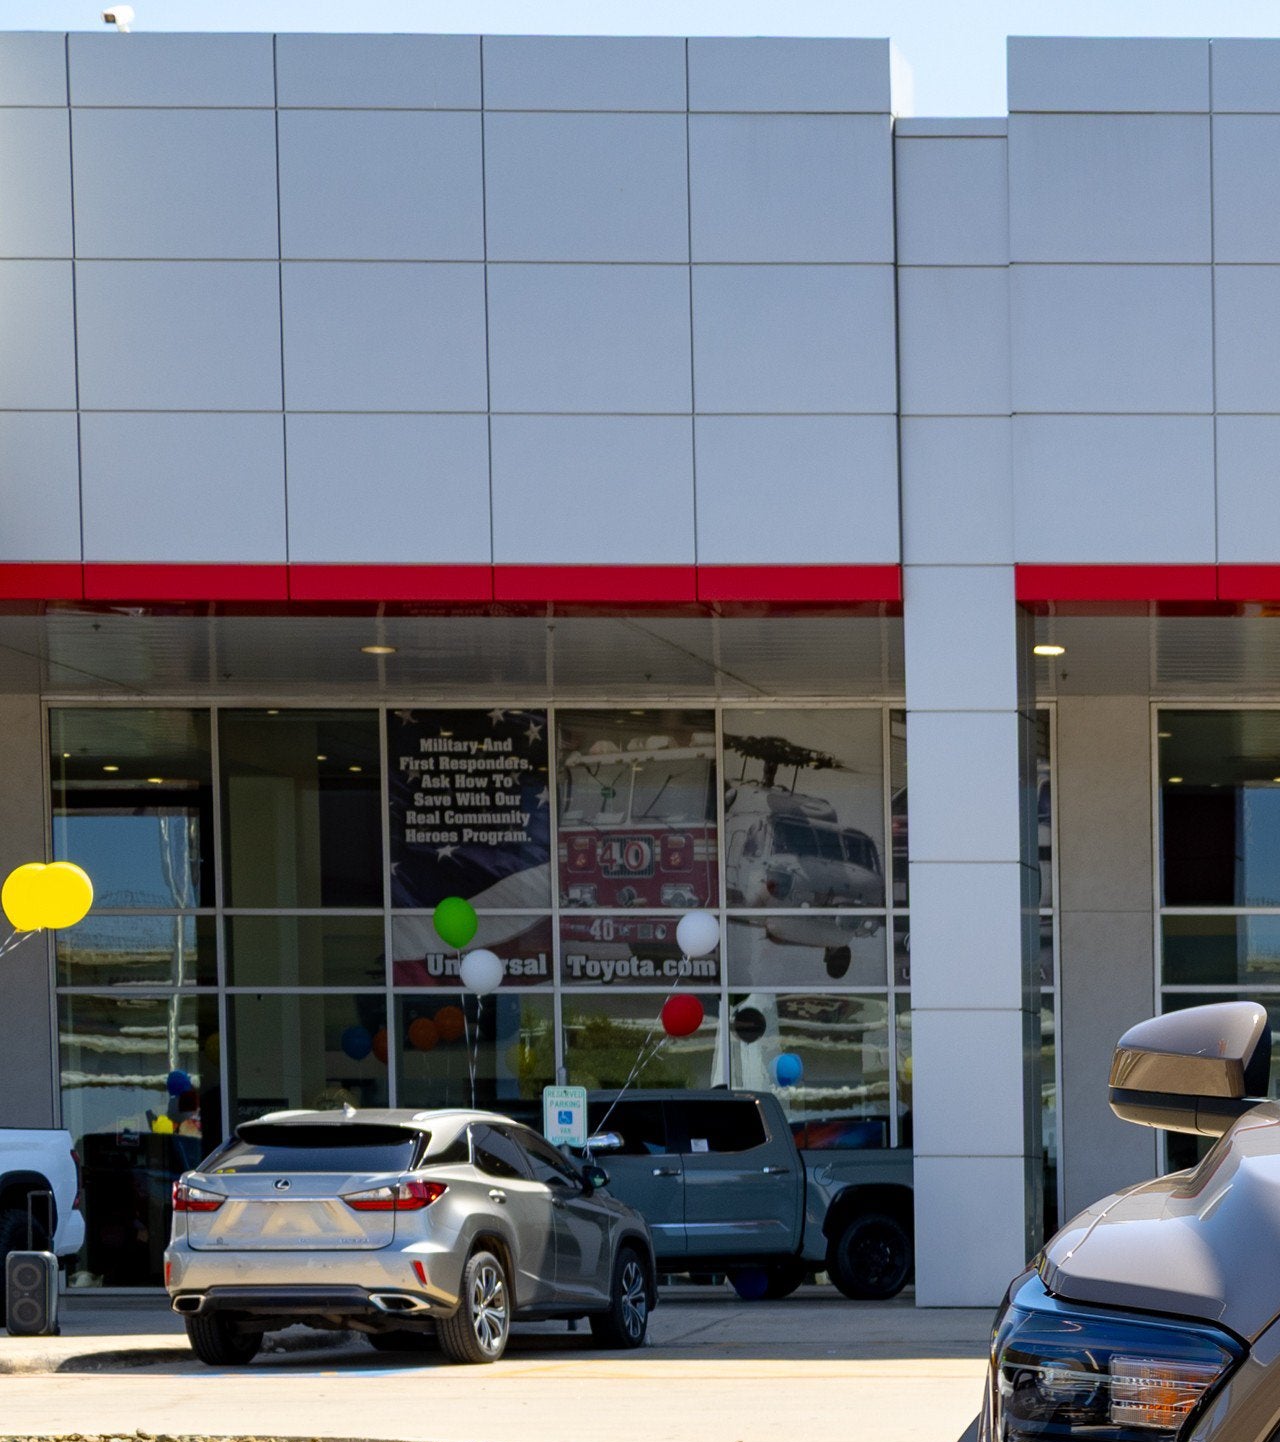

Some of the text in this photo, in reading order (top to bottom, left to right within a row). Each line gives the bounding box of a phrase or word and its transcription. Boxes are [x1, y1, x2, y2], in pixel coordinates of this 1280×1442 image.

[419, 737, 513, 755] Military And
[399, 755, 534, 773] First Responders,
[420, 774, 513, 788] Ask How To
[413, 792, 522, 807] Save With Our
[405, 809, 531, 827] Real Community
[405, 828, 532, 846] Heroes Program.
[598, 840, 650, 872] 40
[590, 918, 614, 941] 40
[567, 954, 716, 983] Toyota.com
[550, 1100, 580, 1108] PARKING
